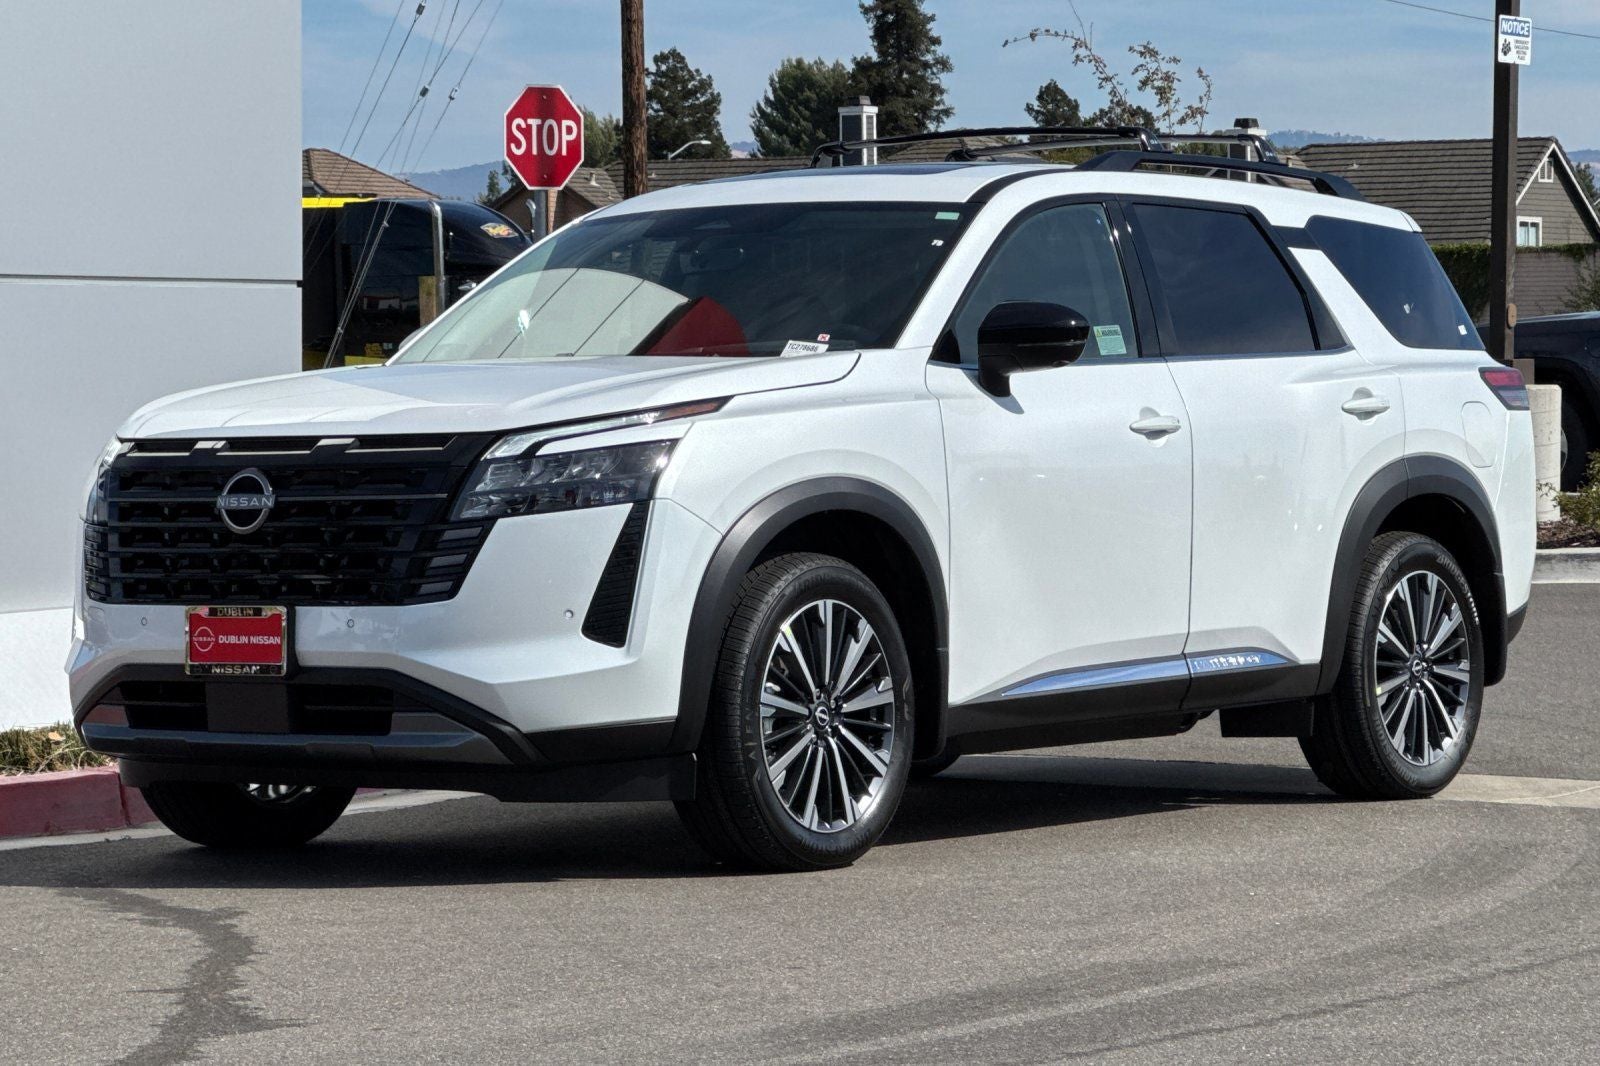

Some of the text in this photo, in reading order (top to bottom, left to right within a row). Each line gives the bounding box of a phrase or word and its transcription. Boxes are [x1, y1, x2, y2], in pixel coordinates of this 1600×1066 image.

[1501, 20, 1530, 35] NOTICE
[510, 117, 578, 156] STOP
[217, 497, 272, 506] NISSAN
[217, 607, 254, 616] DUBLIN
[218, 635, 281, 645] DUBLIN NISSAN
[212, 665, 260, 674] NISSAN
